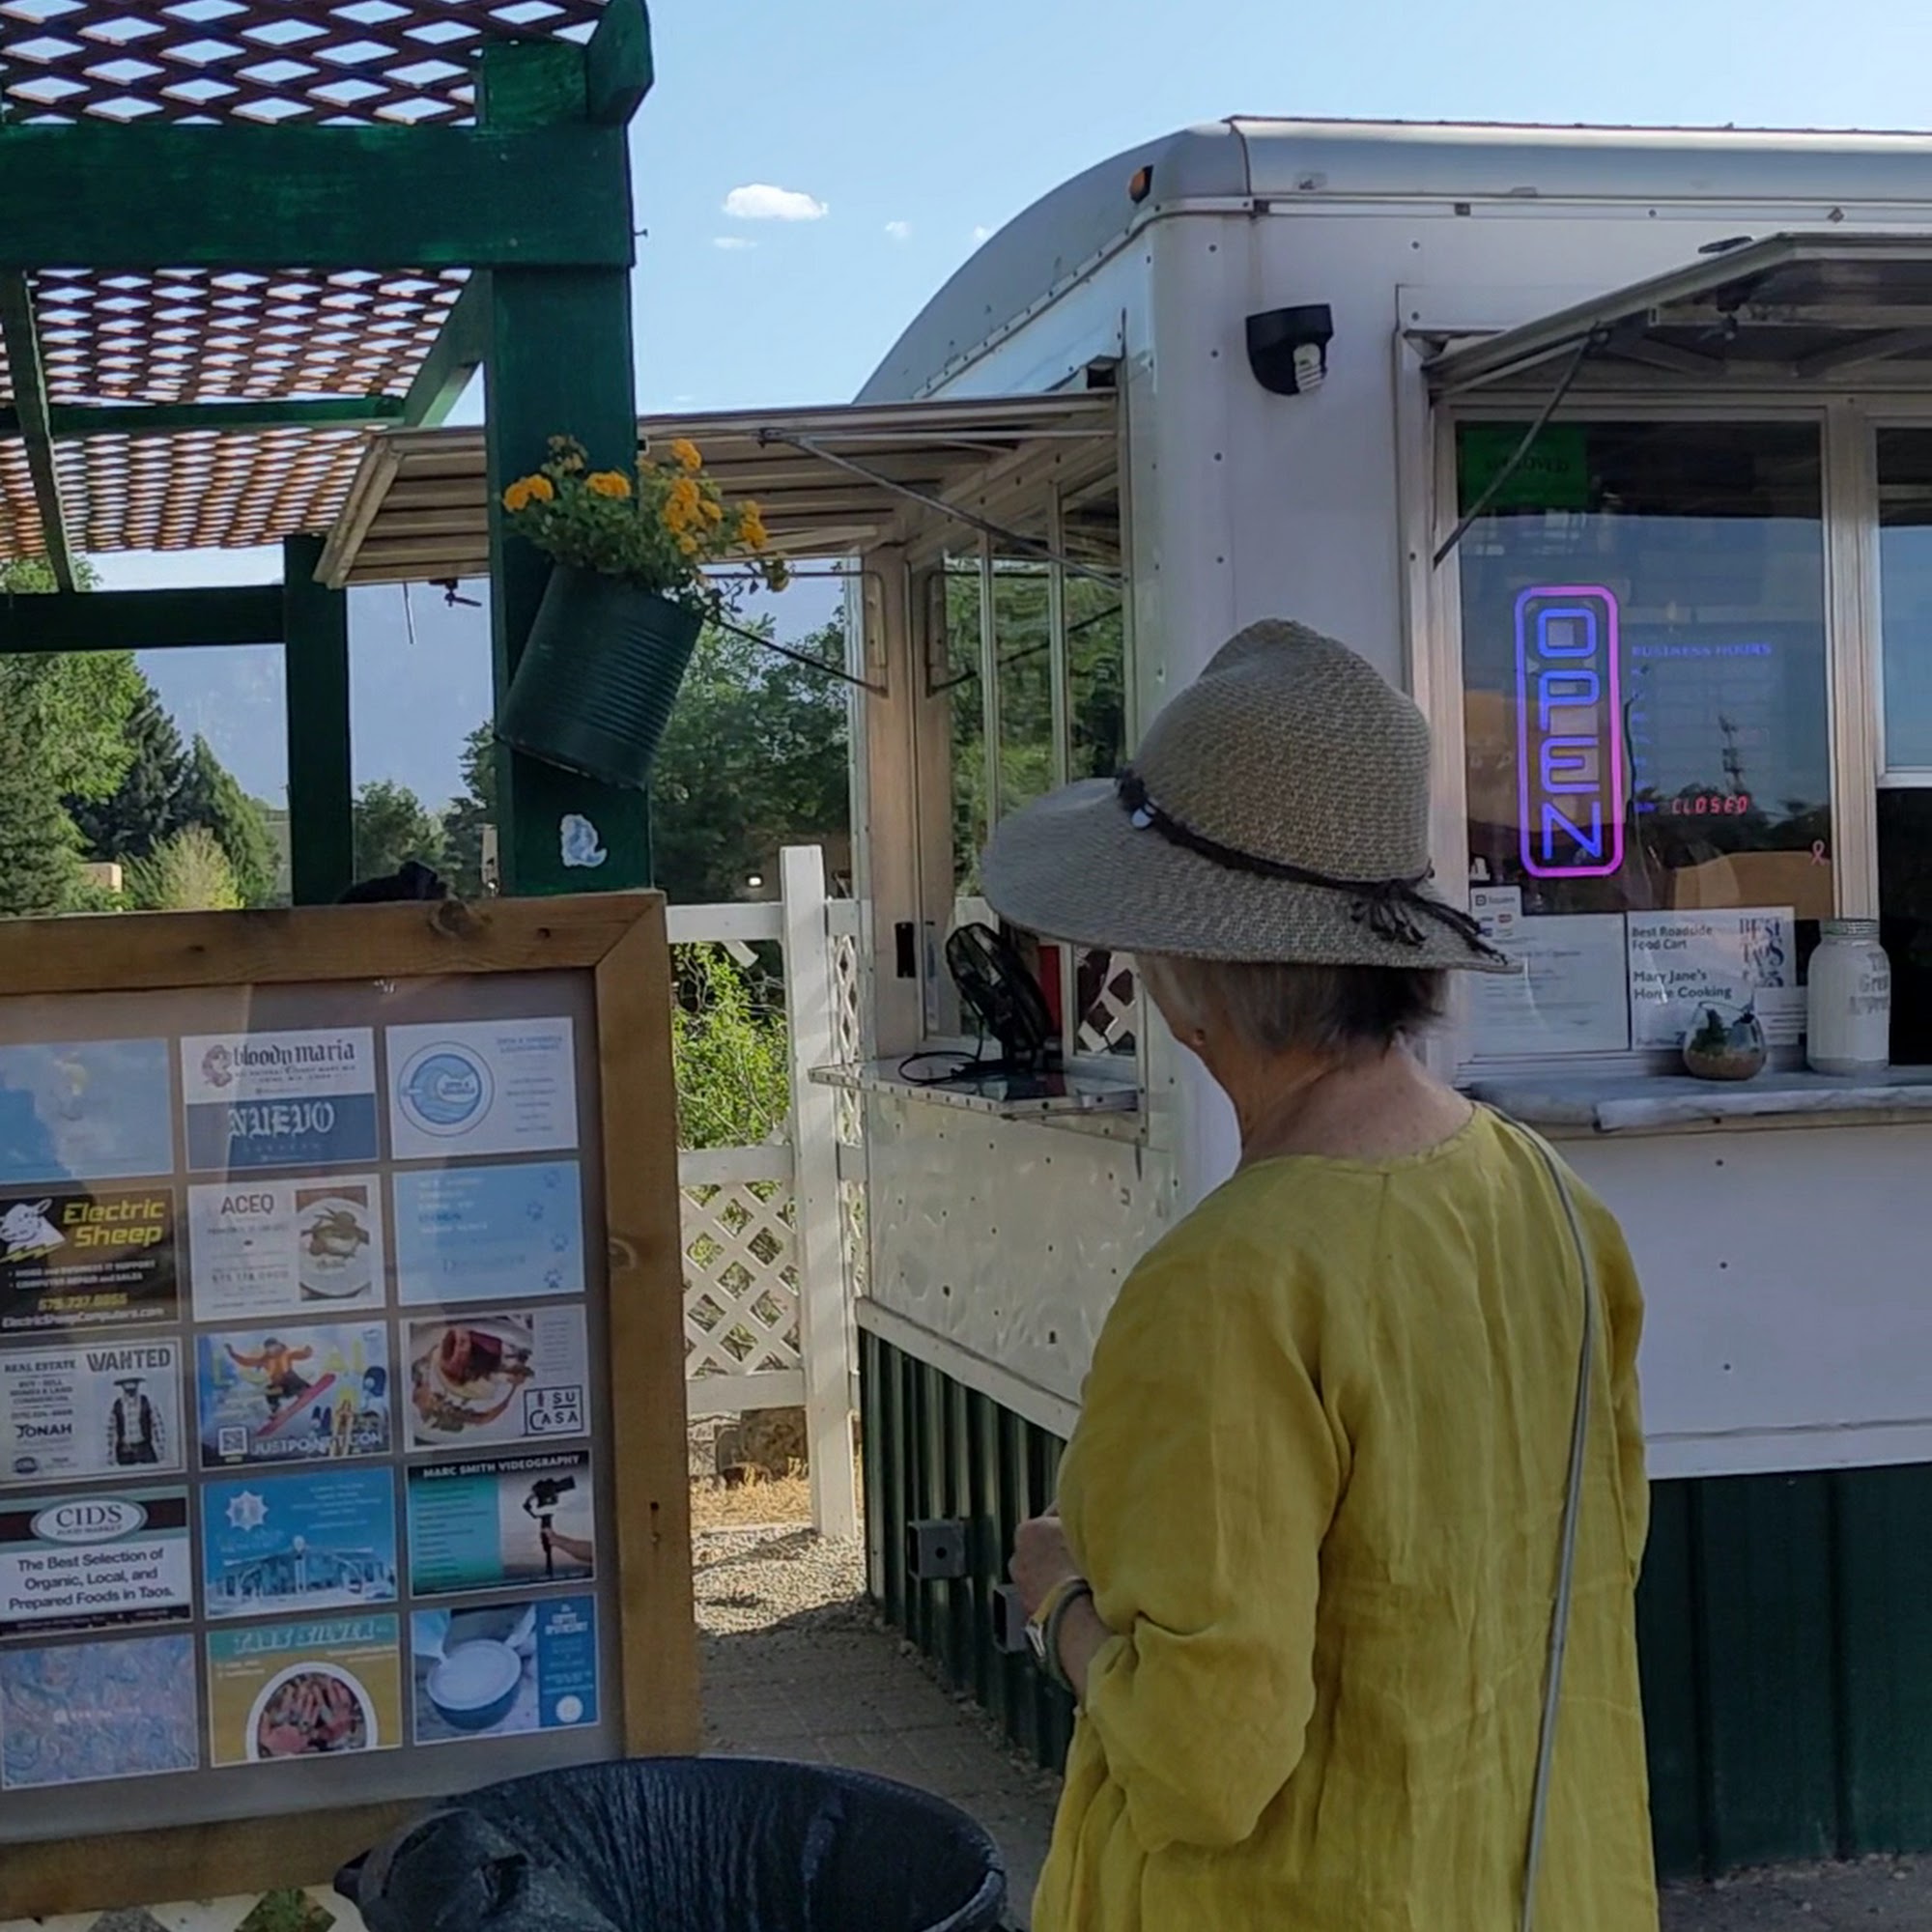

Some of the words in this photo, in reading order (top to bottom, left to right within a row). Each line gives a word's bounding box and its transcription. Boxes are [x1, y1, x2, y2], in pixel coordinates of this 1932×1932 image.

[1538, 608, 1603, 860] OPEN
[1671, 796, 1747, 813] CLOSED
[1632, 926, 1657, 938] Best
[1660, 924, 1713, 937] Roadside
[1633, 939, 1660, 951] Food
[1663, 939, 1687, 950] Cart
[1633, 971, 1665, 985] Mary
[1668, 969, 1708, 982] Jane's
[1677, 986, 1732, 1000] Cooking
[63, 1199, 166, 1224] Electric
[221, 1194, 274, 1215] ACEQ
[74, 1225, 162, 1247] Sheep
[5, 1362, 32, 1373] REAL
[36, 1359, 75, 1371] ESTATE
[87, 1348, 171, 1373] WANTED
[553, 1391, 577, 1405] SU
[15, 1423, 72, 1438] JONAH
[529, 1408, 579, 1432] CASA
[423, 1465, 456, 1478] MARC
[460, 1463, 497, 1475] SMITH
[497, 1455, 580, 1471] VIDEOGRAPHY
[56, 1504, 123, 1528] CIDS
[17, 1560, 43, 1572] The
[47, 1556, 79, 1570] Best
[82, 1549, 146, 1567] Selection
[150, 1548, 163, 1560] of
[25, 1575, 83, 1592] Organic,
[87, 1570, 128, 1585] Local,
[131, 1567, 158, 1581] and
[9, 1594, 73, 1611] Prepared
[76, 1590, 120, 1605] Foods
[123, 1588, 135, 1600] in
[139, 1585, 175, 1599] Taos.
